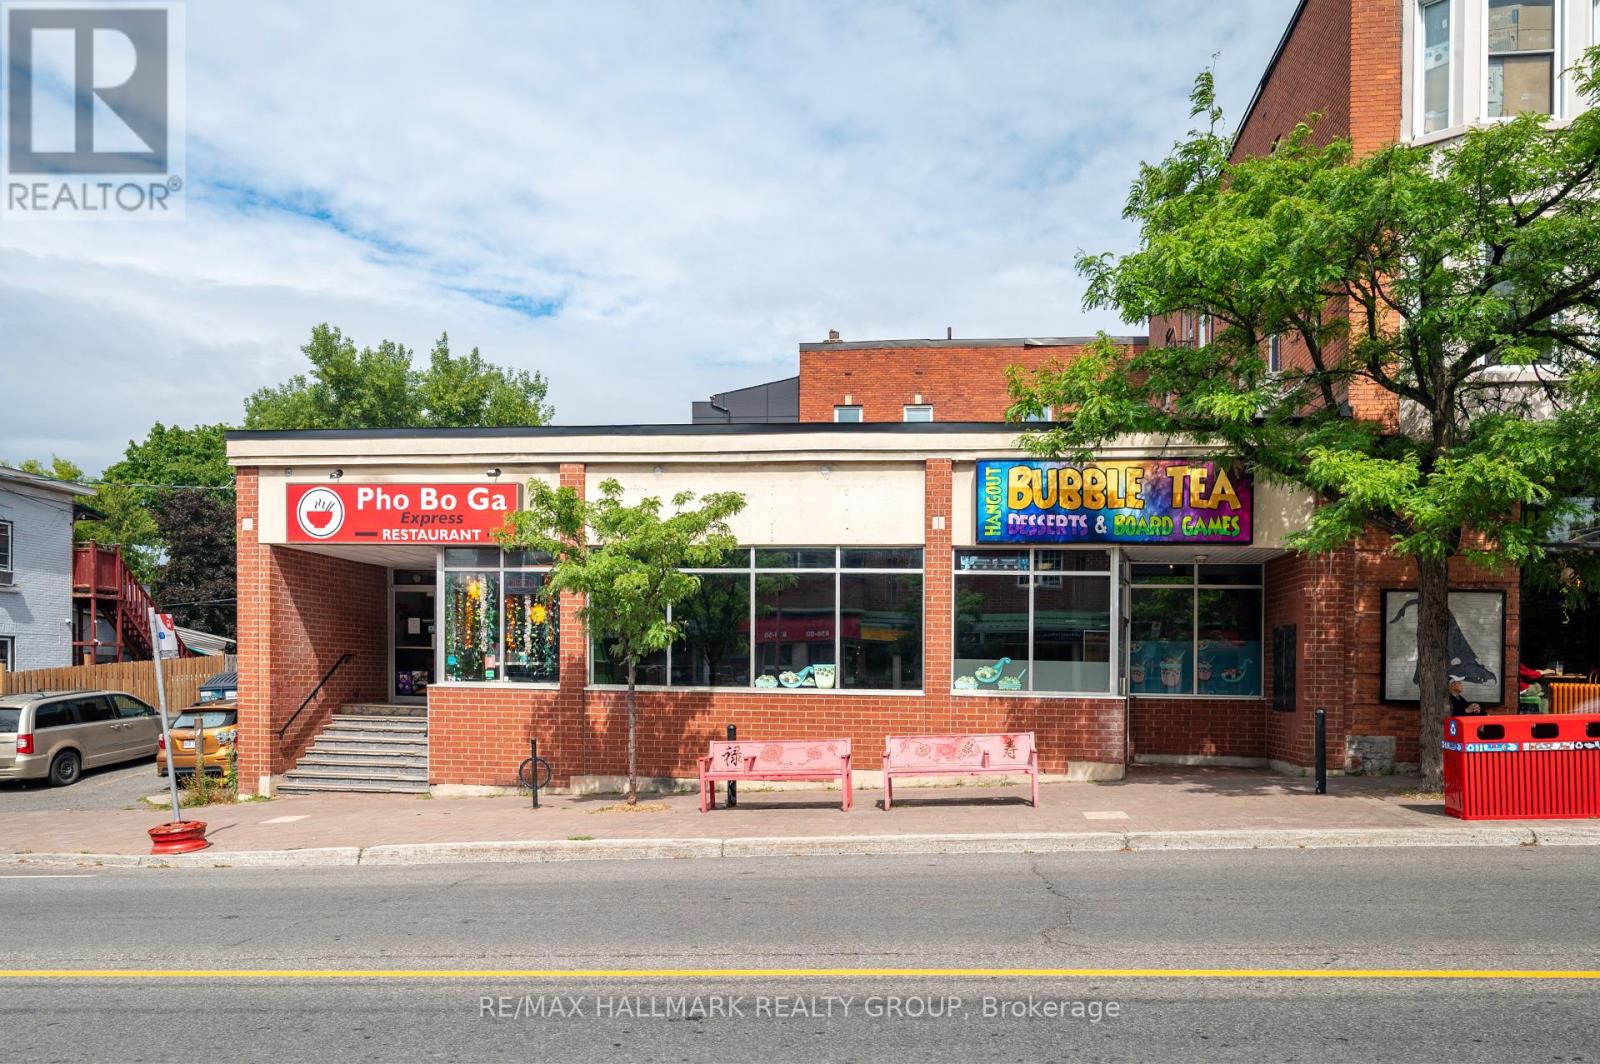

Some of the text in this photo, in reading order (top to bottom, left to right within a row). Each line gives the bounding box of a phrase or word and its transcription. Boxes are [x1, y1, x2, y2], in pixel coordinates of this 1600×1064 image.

[356, 487, 507, 511] Pho Bo Ga
[1007, 465, 1242, 511] BUBBLE TEA
[984, 466, 1002, 536] HANGOUT
[401, 511, 464, 527] Express
[1007, 513, 1241, 537] DESSERTS & BOARD GAMES
[382, 529, 482, 541] RESTAURANT
